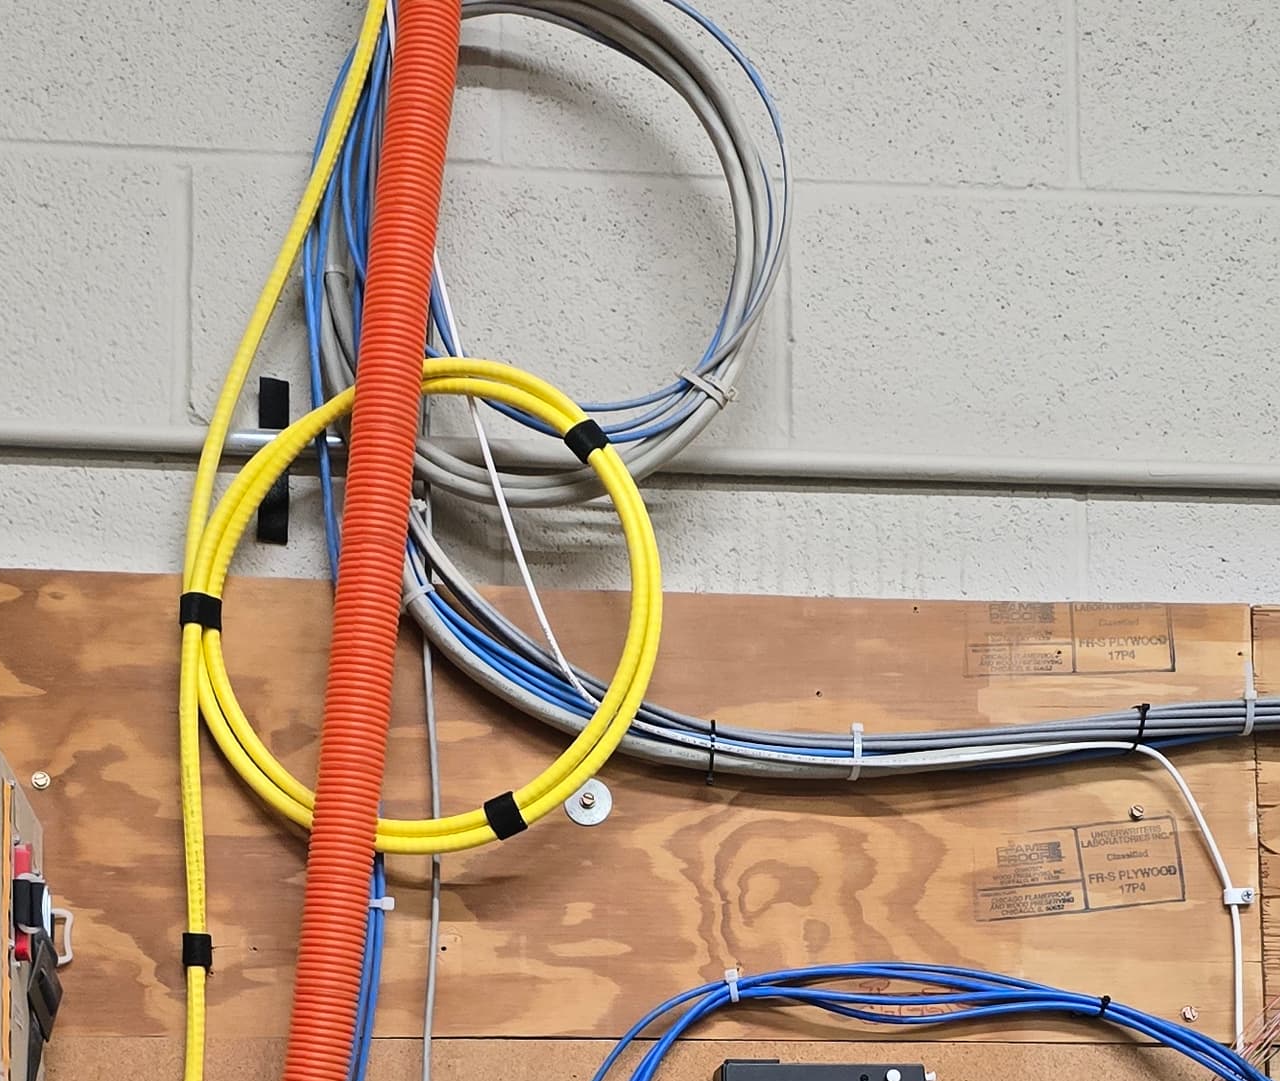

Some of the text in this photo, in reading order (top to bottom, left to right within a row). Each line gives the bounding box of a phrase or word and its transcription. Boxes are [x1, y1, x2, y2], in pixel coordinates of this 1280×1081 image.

[1109, 634, 1167, 646] PLYWOOD
[1108, 650, 1135, 660] 17P4
[1089, 866, 1177, 884] FR-S PLYWOOD
[1120, 884, 1146, 894] 17P4
